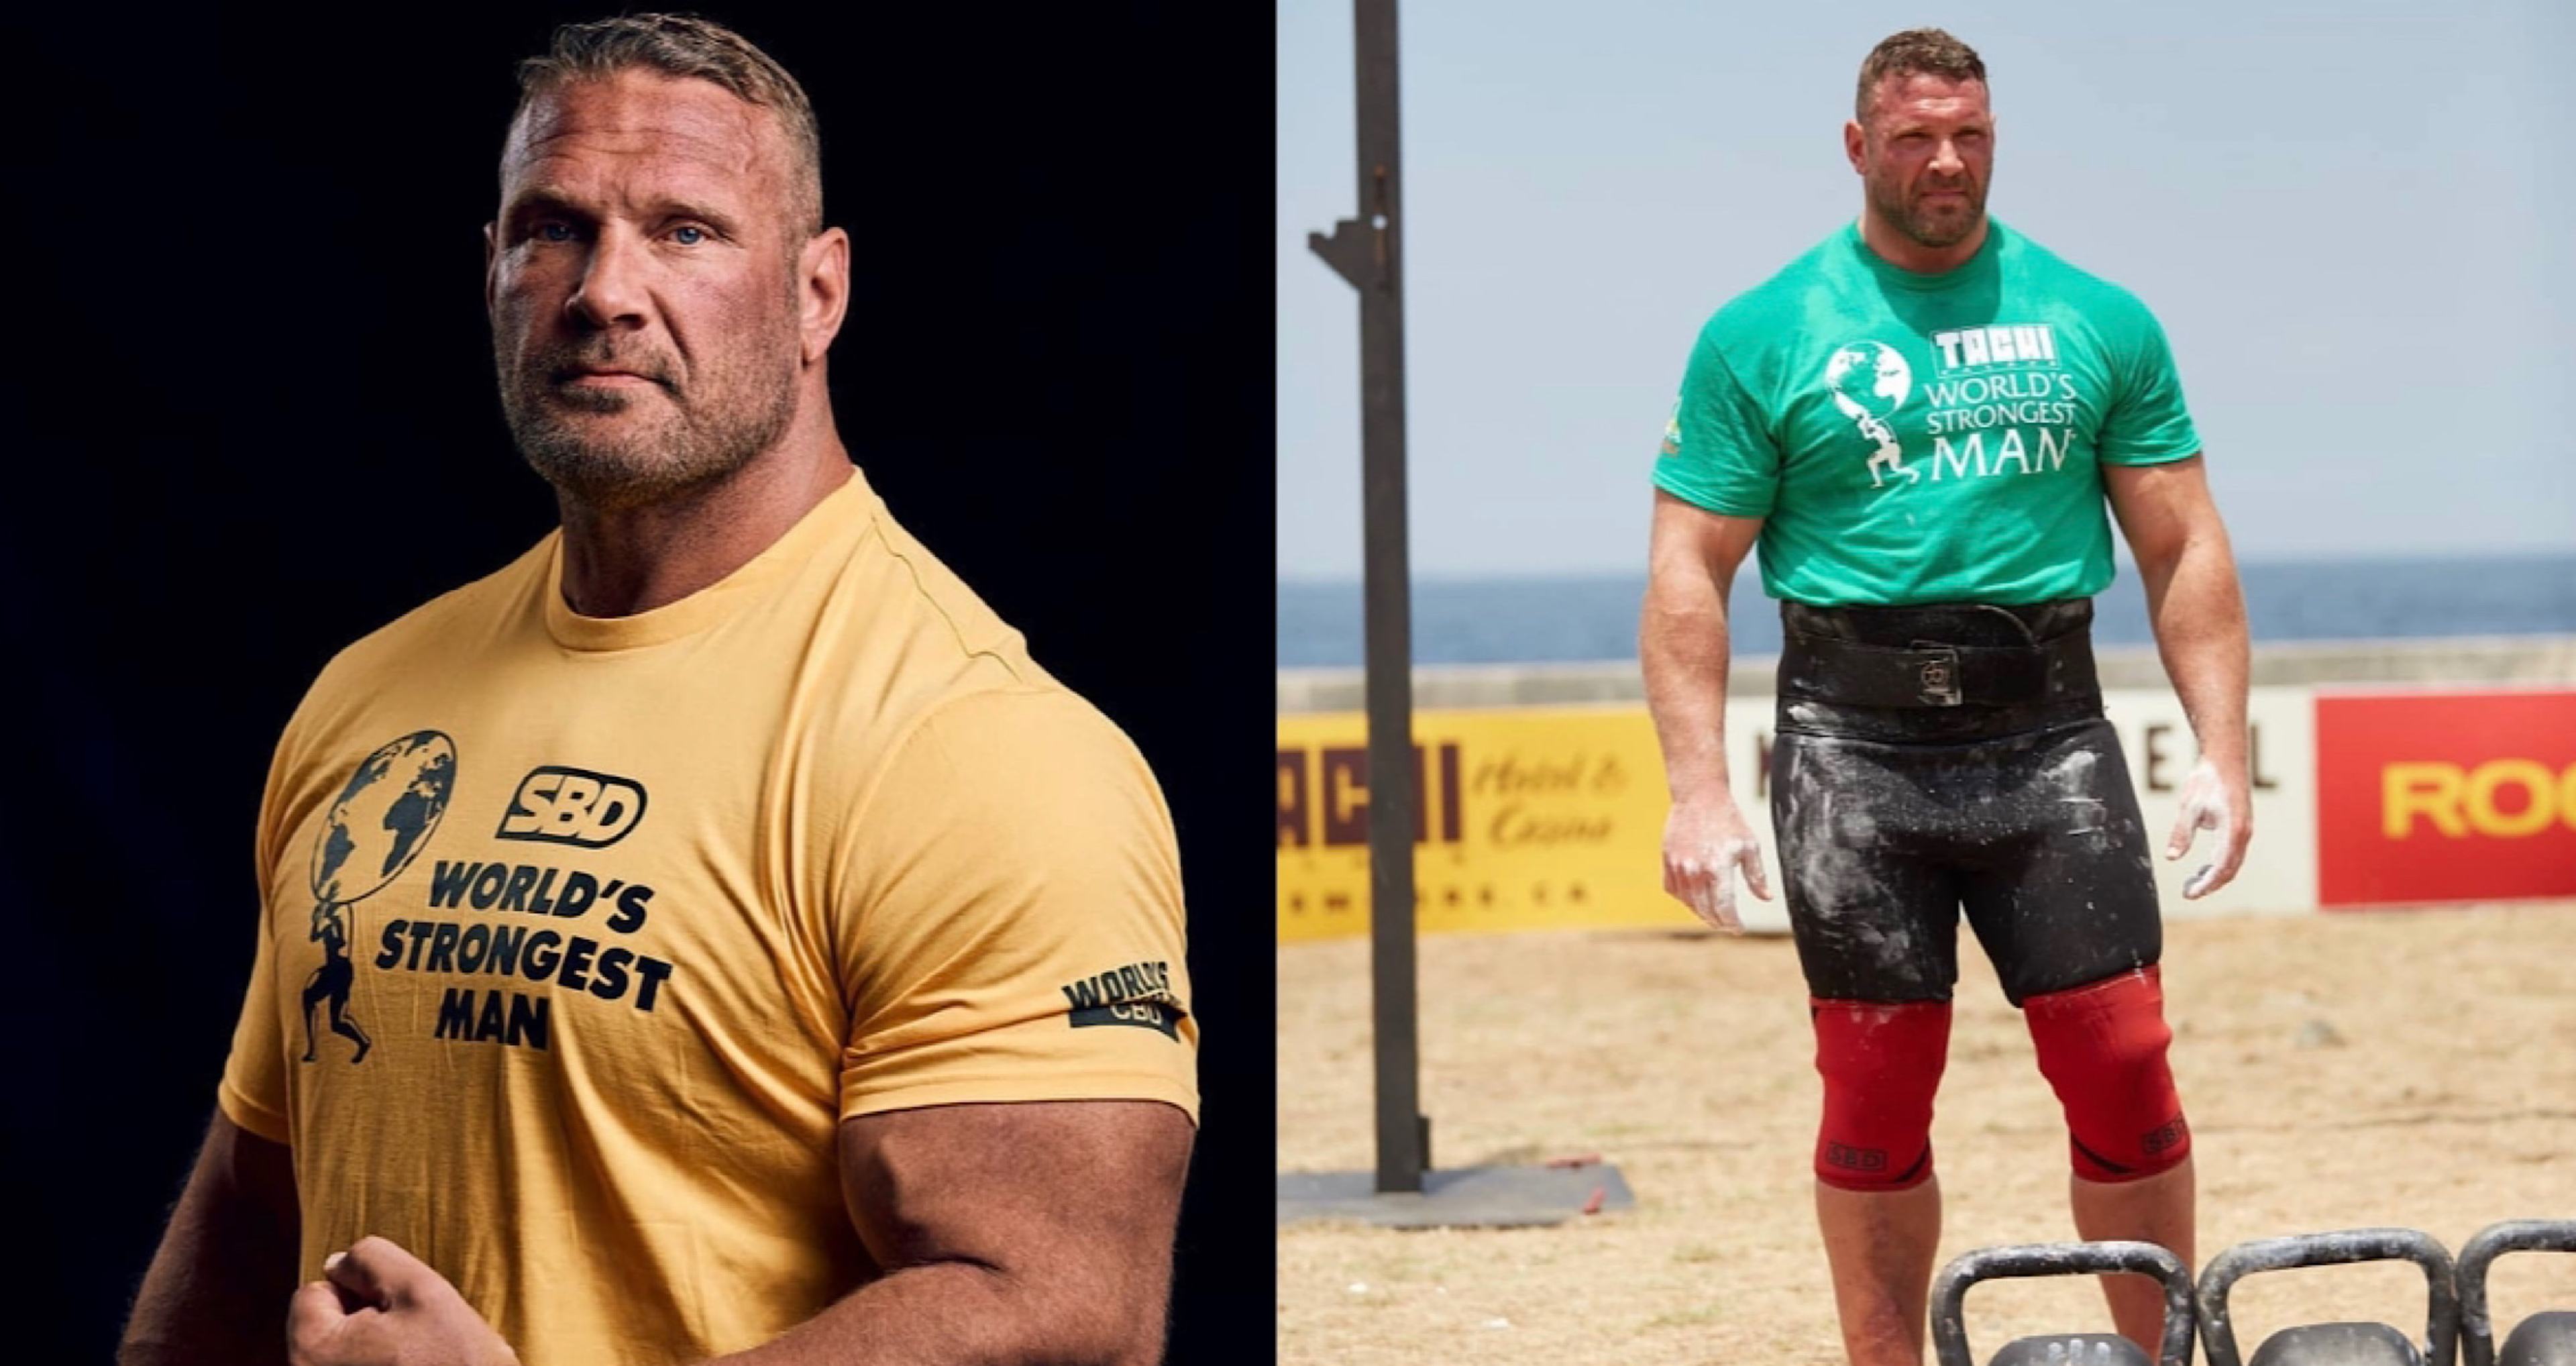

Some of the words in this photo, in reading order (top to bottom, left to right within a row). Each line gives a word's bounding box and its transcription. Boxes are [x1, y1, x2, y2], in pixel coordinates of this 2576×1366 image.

[1923, 373, 2078, 408] WORLD'S
[1926, 401, 2077, 435] STRONGEST
[1931, 427, 2074, 482] MAN
[502, 774, 639, 841] SBD
[429, 860, 655, 934] WORLD'S
[376, 919, 674, 1013] STRONGEST
[434, 988, 551, 1051] MAN
